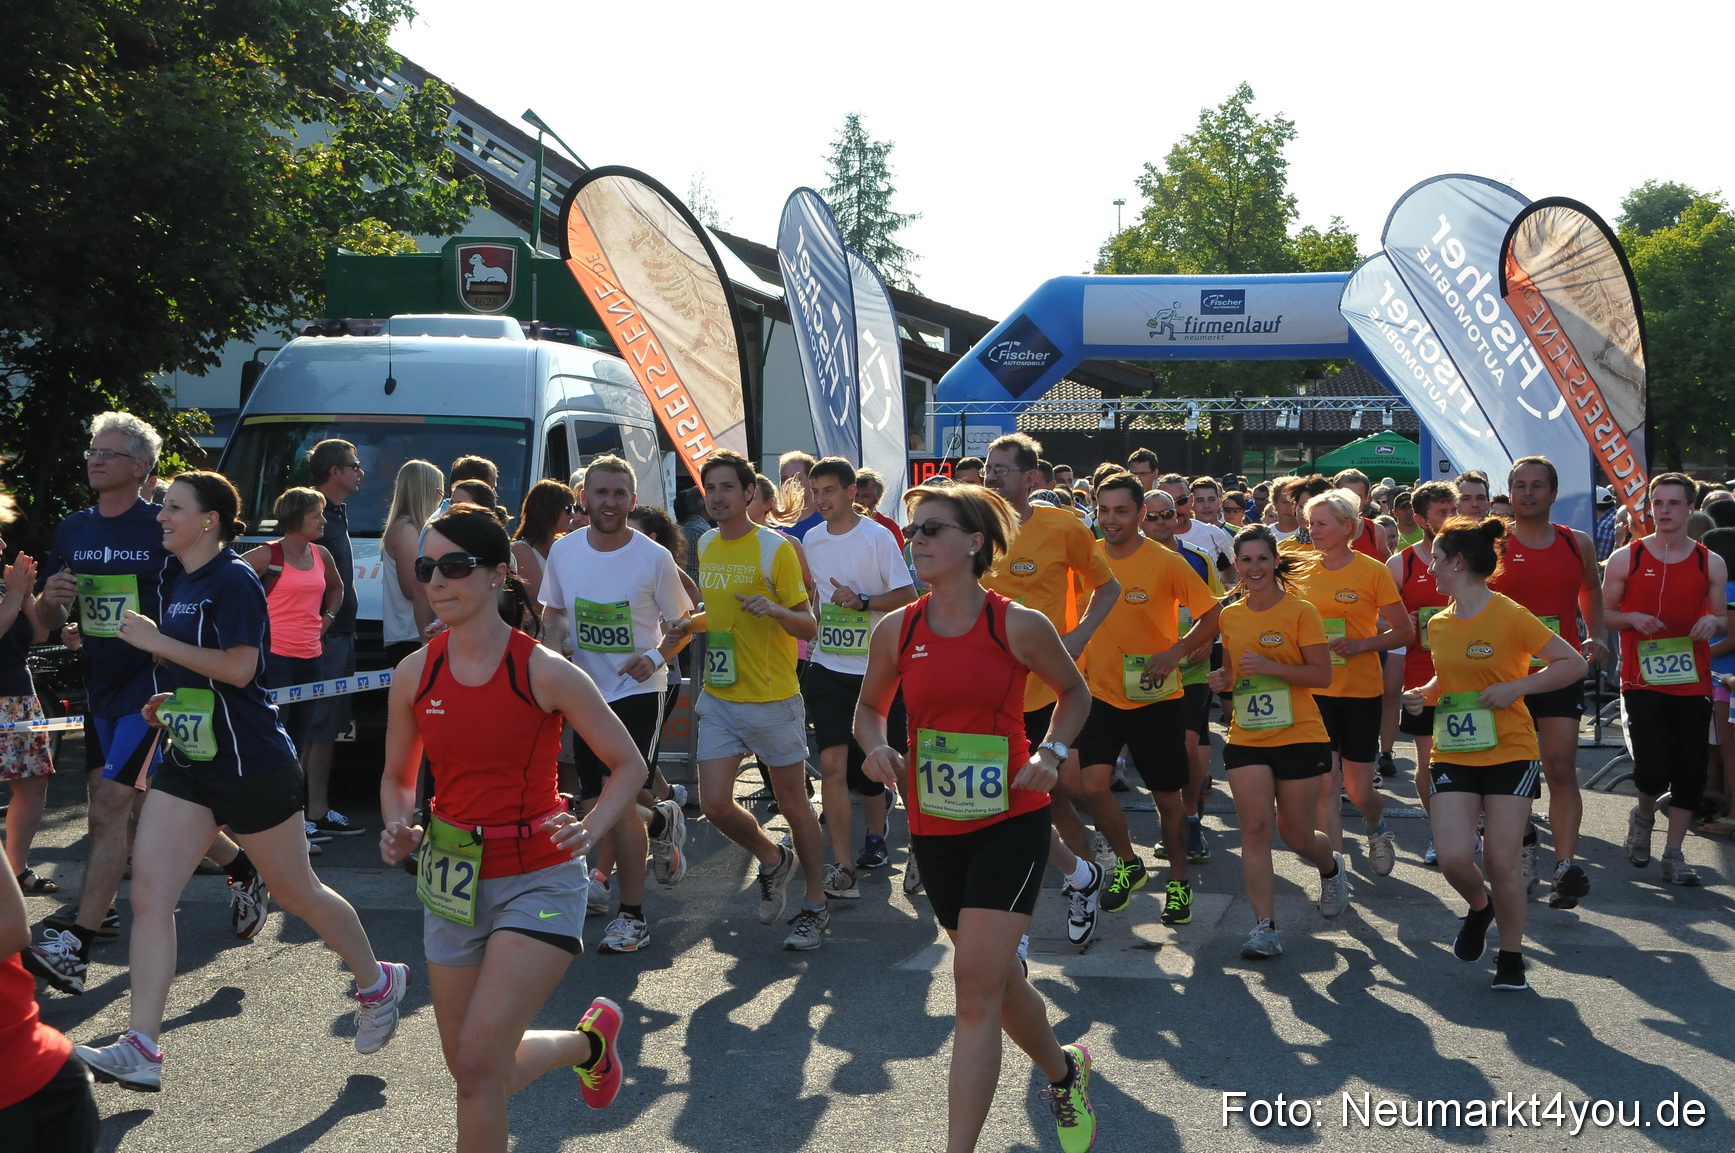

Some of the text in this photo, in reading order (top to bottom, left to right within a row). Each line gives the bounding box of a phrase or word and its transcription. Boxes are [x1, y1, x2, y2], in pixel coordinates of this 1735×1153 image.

[474, 297, 499, 307] 1628
[1185, 315, 1283, 333] firmenlauf
[998, 350, 1051, 360] Fischer
[74, 550, 150, 561] EURO POLES
[727, 564, 756, 574] STEYR
[734, 574, 754, 584] 2014
[699, 572, 732, 590] RUN
[85, 596, 126, 621] 357
[580, 623, 630, 646] 5098
[822, 627, 867, 647] 5097
[1642, 653, 1693, 675] 1326
[1247, 693, 1274, 717] 43
[1446, 713, 1476, 738] 64
[919, 760, 1003, 799] 1318
[421, 840, 474, 901] 1312
